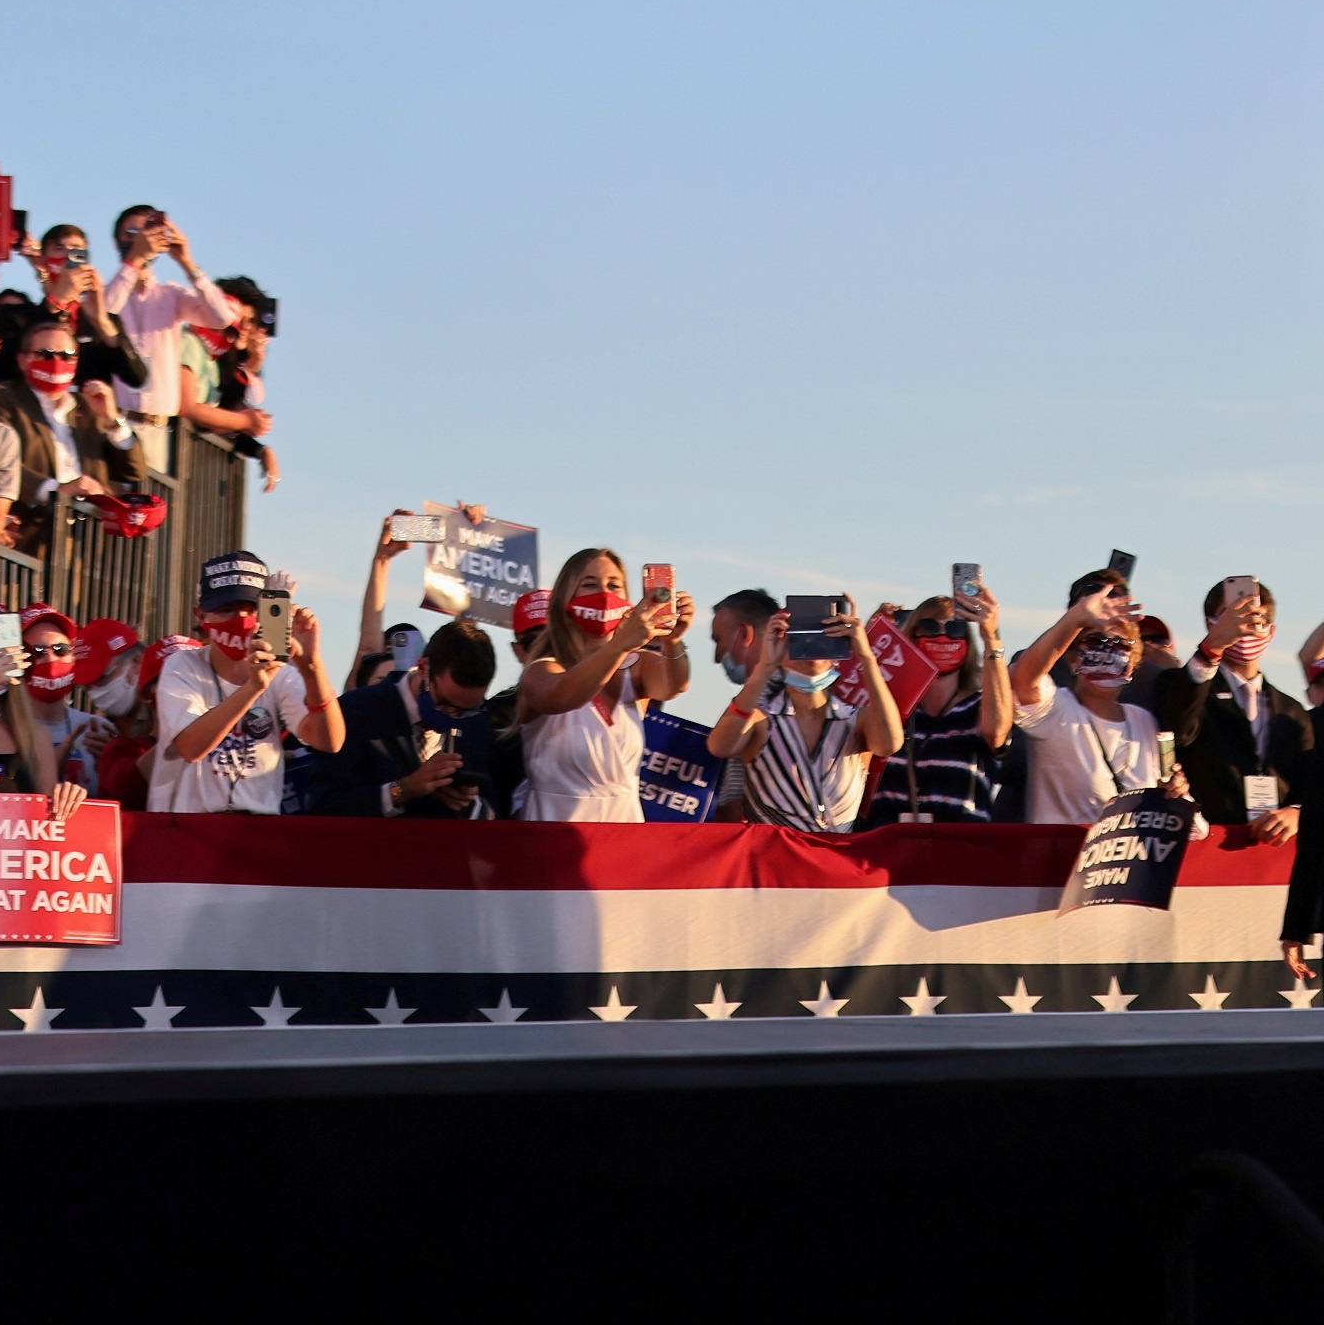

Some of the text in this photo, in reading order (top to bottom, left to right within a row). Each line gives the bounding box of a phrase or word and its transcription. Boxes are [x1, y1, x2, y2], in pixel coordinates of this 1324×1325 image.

[458, 527, 505, 553] MAKE
[431, 544, 535, 589] AMERICA
[484, 585, 522, 607] AGA
[1118, 811, 1185, 833] GREAT
[1076, 836, 1179, 873] AMERICA
[1083, 867, 1131, 890] MAKE
[31, 890, 114, 915] AGAIN
